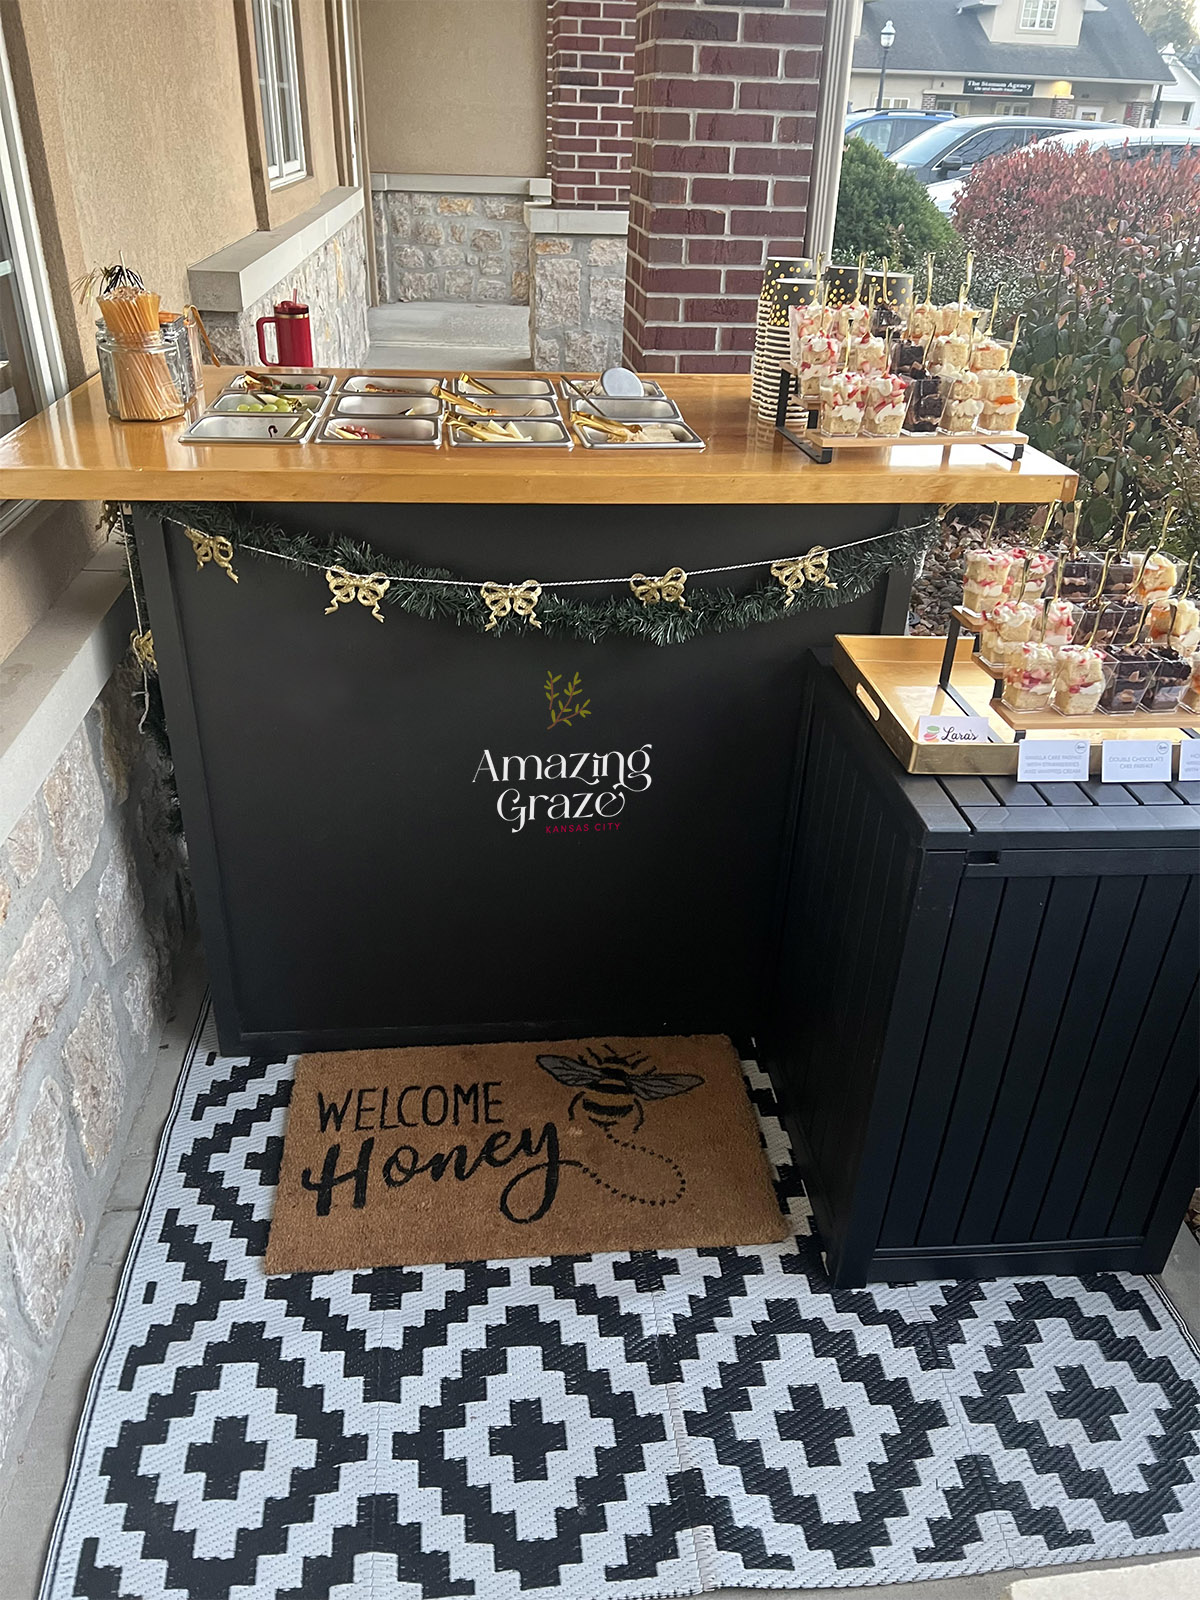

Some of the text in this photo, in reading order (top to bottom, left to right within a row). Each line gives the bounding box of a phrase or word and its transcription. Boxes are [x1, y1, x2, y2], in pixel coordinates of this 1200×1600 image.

[941, 726, 979, 743] Lara's
[472, 743, 653, 793] Amazing
[496, 787, 626, 834] Graze
[545, 822, 621, 834] KANSAS CITY
[317, 1081, 504, 1133] WELCOME
[301, 1122, 567, 1225] Honey
